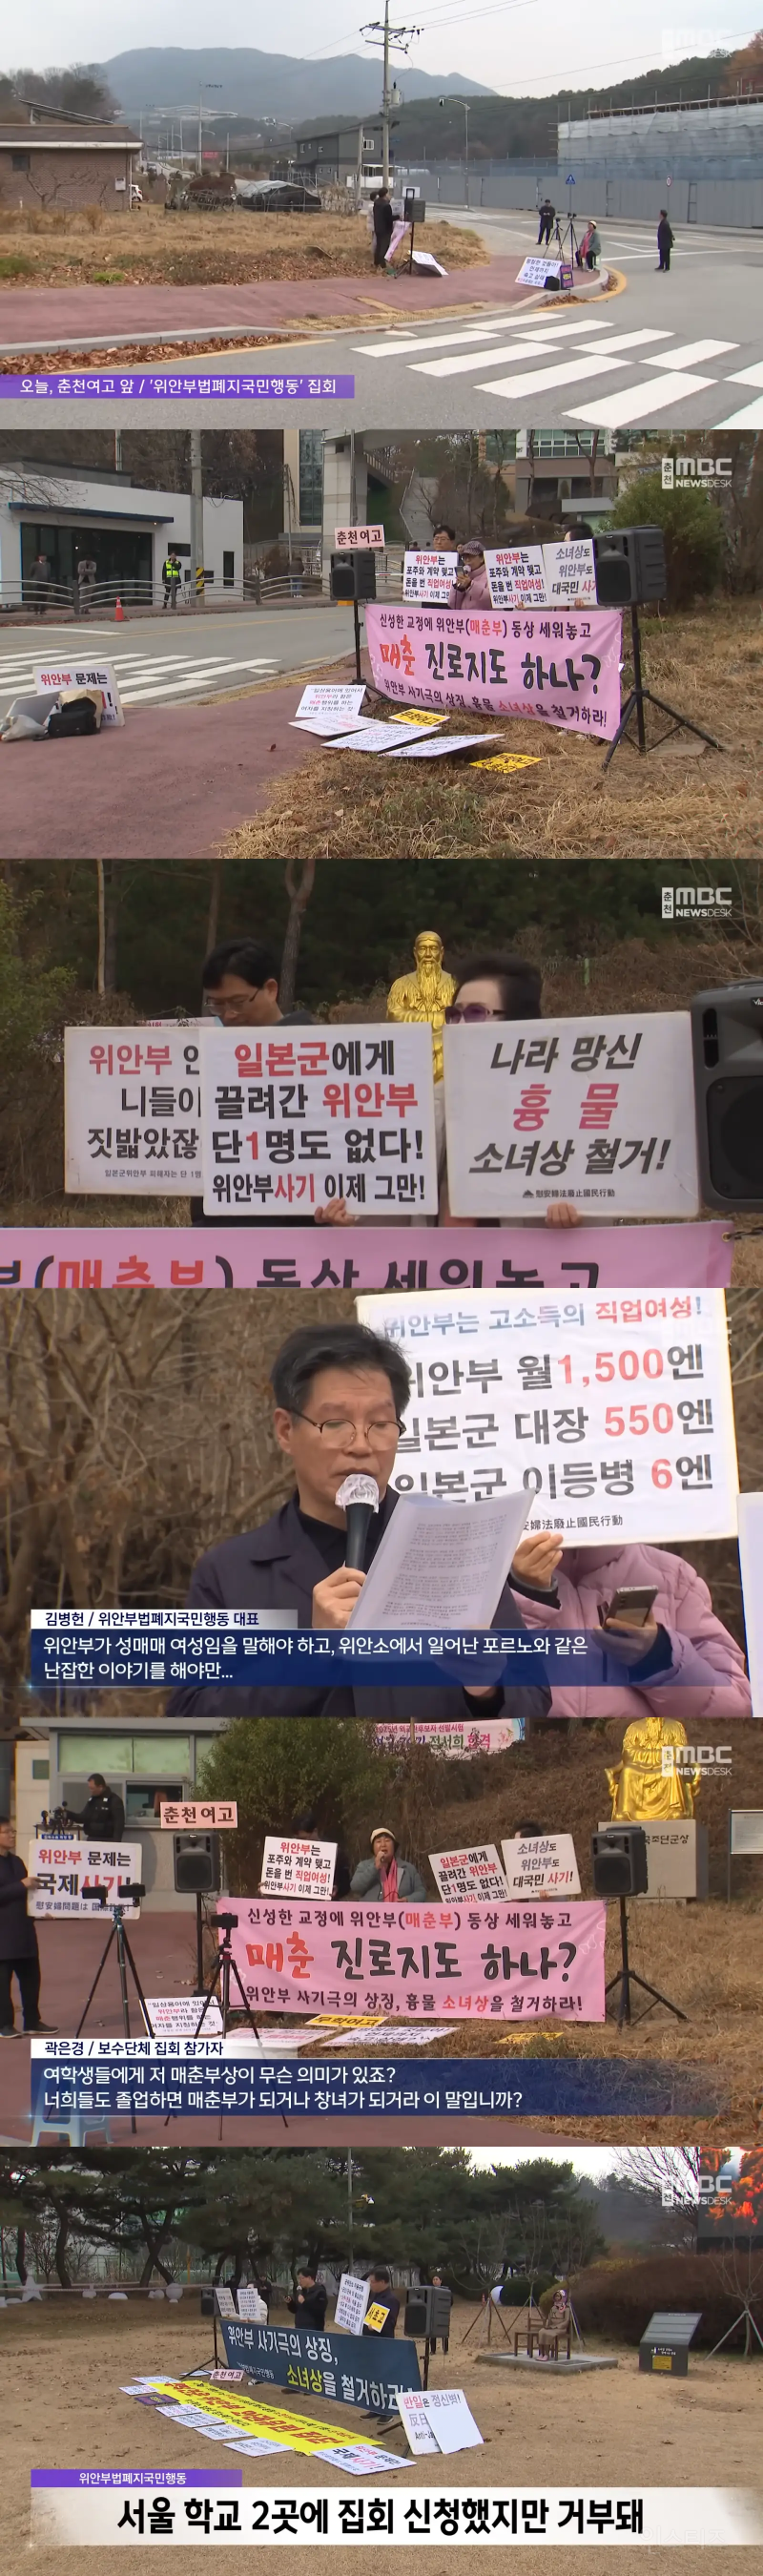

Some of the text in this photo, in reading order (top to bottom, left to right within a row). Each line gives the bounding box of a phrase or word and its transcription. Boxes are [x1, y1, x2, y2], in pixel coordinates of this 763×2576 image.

[336, 529, 382, 546] 춘천여고
[416, 555, 445, 565] 위안부는
[496, 552, 529, 565] 위안부는
[556, 545, 590, 560] 소녀상도
[489, 566, 508, 577] 포주와
[559, 563, 592, 577] 위안부도
[515, 579, 545, 591] 직업여성!
[552, 580, 579, 594] 대국민
[493, 594, 519, 604] 위안부사기
[380, 613, 591, 638] 신성한 교정에 위안부(매춘부) 동상 세워놓고
[379, 634, 602, 695] 매춘 진로지도 하나?
[41, 673, 108, 686] 위안부 문제는
[384, 678, 608, 727] 위안부 사기극의 흉물 소녀상을 철거하라!
[90, 1044, 173, 1076] 위안부
[234, 1040, 395, 1078] 일본군에게
[490, 1032, 643, 1075] 나라 망신
[121, 1086, 201, 1118] 니들이
[215, 1083, 418, 1120] 끌려간 위안부
[513, 1083, 620, 1132] 흉 물
[212, 1128, 423, 1164] 단1명도 없다!
[468, 1137, 671, 1176] 소녀상 철거!
[150, 1170, 177, 1178] 피해자는
[212, 1174, 424, 1203] 위안부사기 이제 그만!
[386, 1296, 702, 1338] 위안부는 고소득의 직업여성!
[517, 1343, 705, 1390] 월1,500엔
[515, 1406, 589, 1445] 대장
[605, 1399, 713, 1437] 550엔
[523, 1460, 634, 1500] 이등병
[651, 1454, 713, 1491] 6엔
[163, 1806, 235, 1823] 춘천여고
[280, 1841, 320, 1856] 위안부는
[517, 1840, 557, 1855] 소녀상도
[38, 1849, 132, 1867] 위안부 문제는
[267, 1854, 331, 1869] 포주와 계약 맺고
[440, 1851, 488, 1868] 일본군에게
[521, 1857, 560, 1871] 위안부도
[266, 1867, 330, 1883] 돈을 직업여성!
[438, 1862, 498, 1881] 끌려간 위안부
[513, 1871, 573, 1888] 대국민 사기!
[264, 1880, 311, 1894] 위안부사기 이제
[442, 1876, 504, 1895] 단1명도 없다!
[247, 1908, 572, 1931] 신성한 교정에 위안부(매춘부) 동상 세워놓고
[245, 1931, 577, 1983] 매춘 진로지도 하나?
[245, 1986, 583, 2013] 위안부 사기극의 상징, 흉물 소녀상을 철거하라!
[228, 2325, 339, 2366] 위안부 사기극의 상징,
[212, 2370, 241, 2379] 춘천여고
[287, 2364, 337, 2397] 소녀상을
[403, 2395, 430, 2409] 반일은
